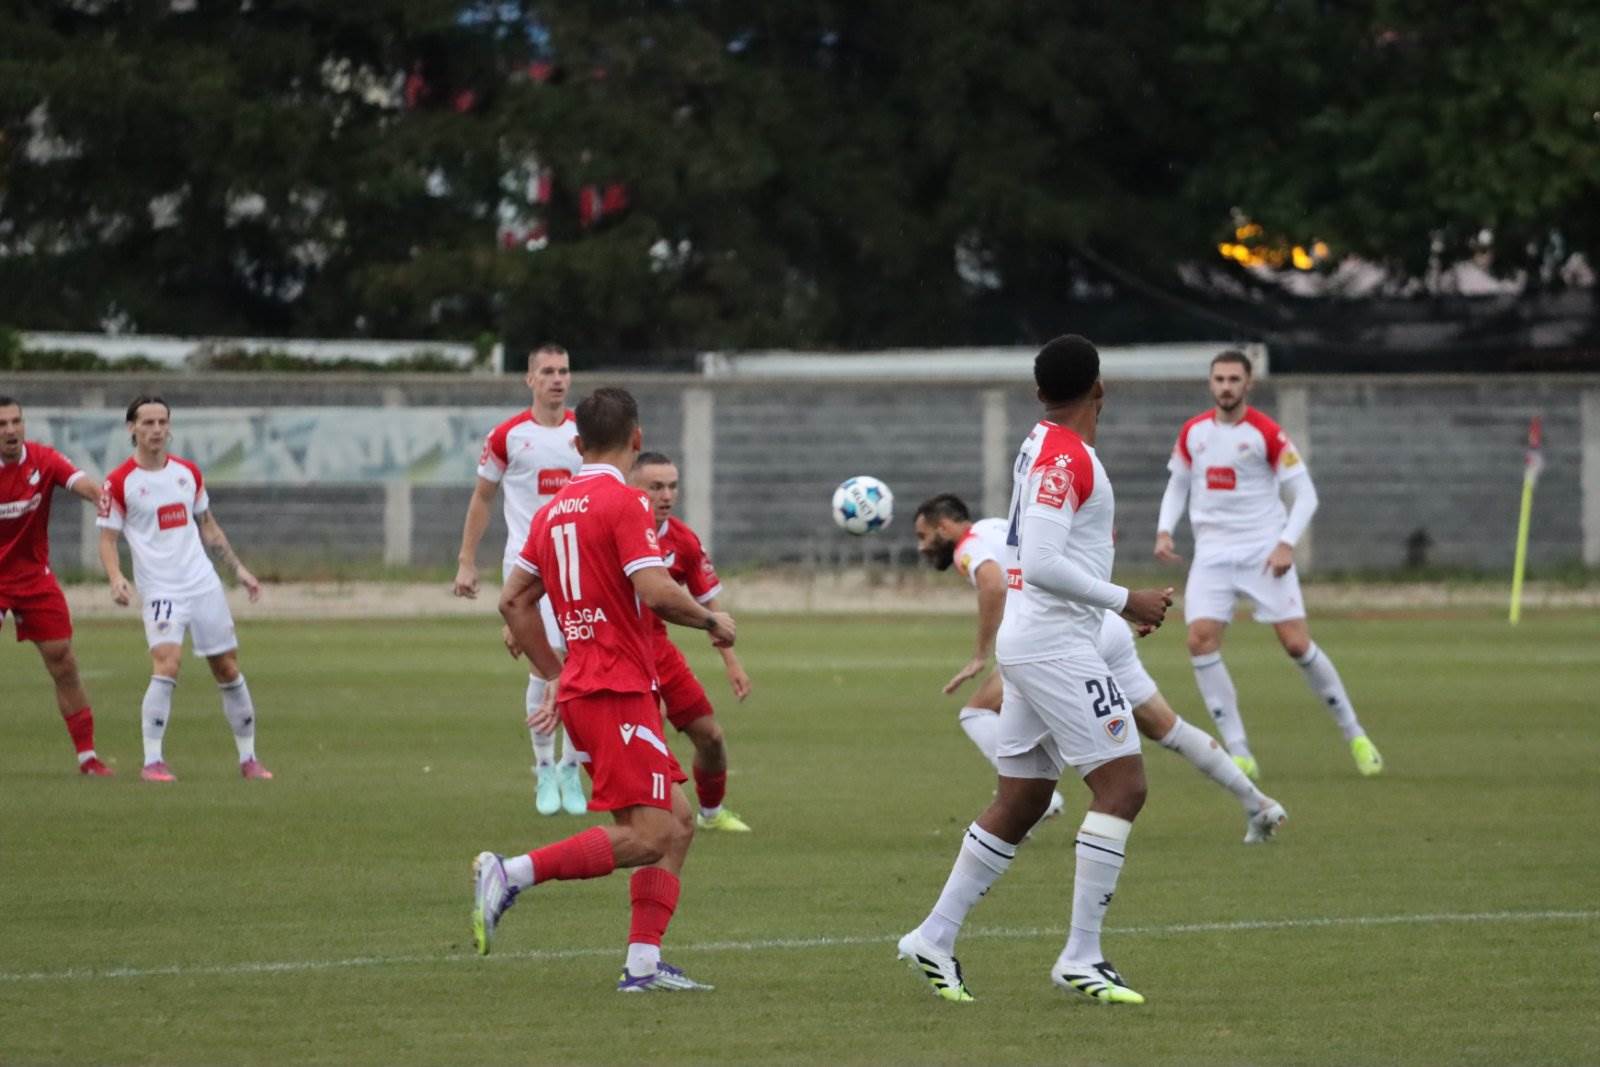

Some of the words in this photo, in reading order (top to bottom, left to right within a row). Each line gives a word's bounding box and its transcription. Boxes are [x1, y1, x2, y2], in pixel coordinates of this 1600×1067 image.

[550, 522, 582, 602] 11
[151, 599, 173, 621] 77
[1085, 676, 1126, 718] 24
[651, 772, 665, 800] 11
